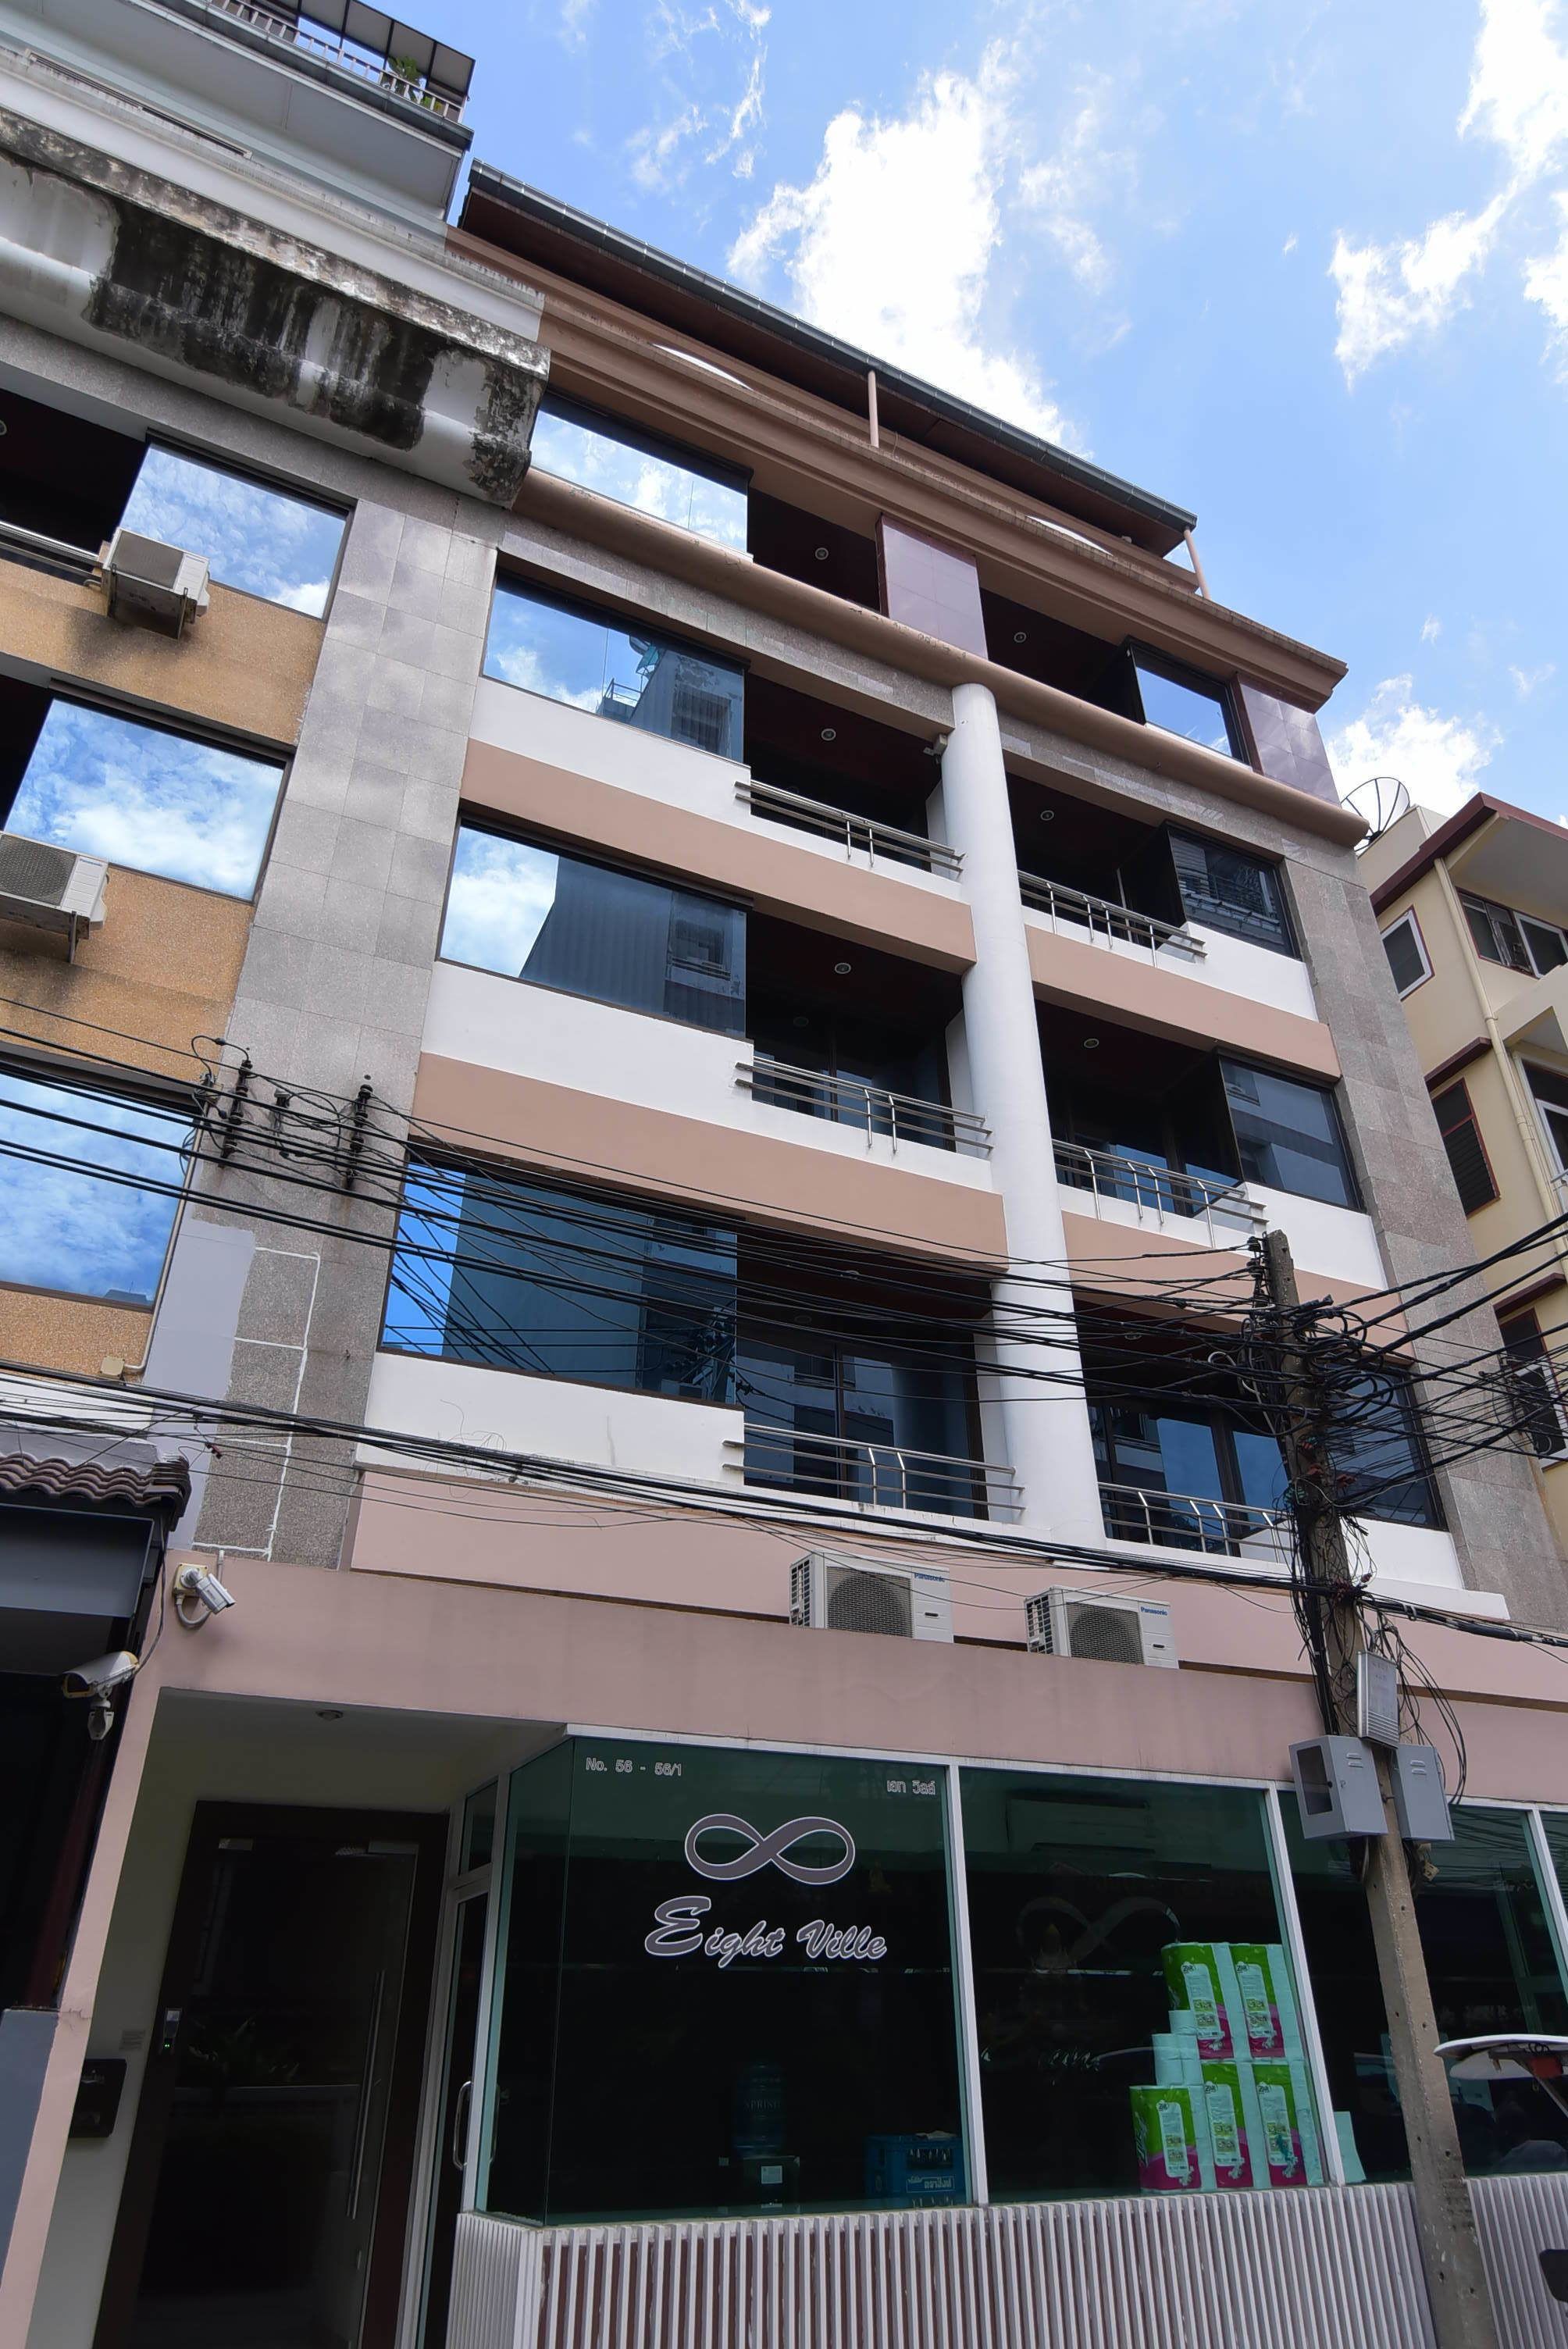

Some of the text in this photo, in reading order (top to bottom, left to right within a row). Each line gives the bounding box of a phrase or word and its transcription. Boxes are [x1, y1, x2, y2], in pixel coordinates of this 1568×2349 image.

[586, 1757, 608, 1771] No.
[615, 1759, 633, 1773] 56
[654, 1762, 682, 1776] 56/1
[645, 1895, 888, 1968] Eight Ville
